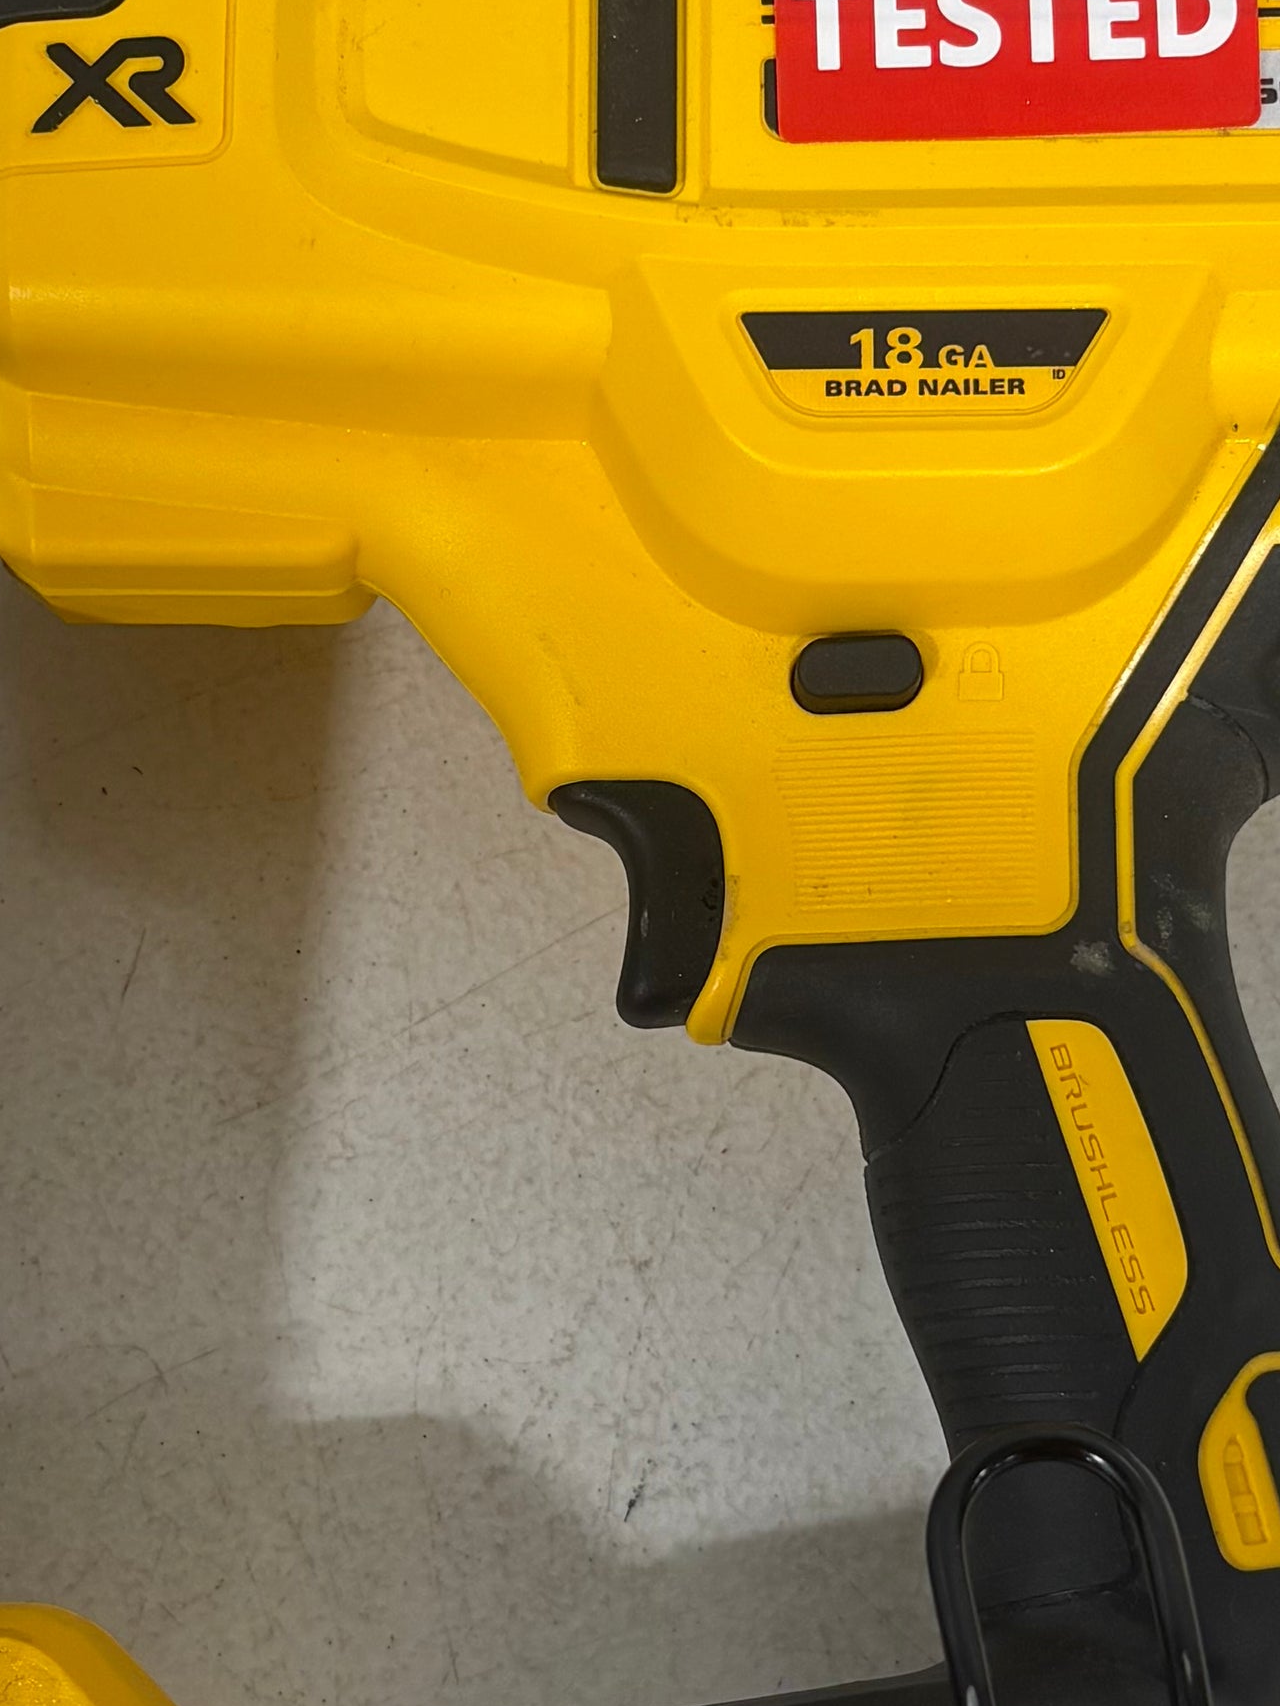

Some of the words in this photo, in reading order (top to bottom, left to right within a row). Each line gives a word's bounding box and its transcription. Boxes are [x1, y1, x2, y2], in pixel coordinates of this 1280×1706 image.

[31, 36, 197, 134] XR
[849, 326, 924, 370] 18
[937, 344, 996, 369] GA
[824, 379, 908, 397] BRAD
[918, 378, 1026, 396] NAILER
[1049, 1042, 1156, 1315] BRUSHLESS
